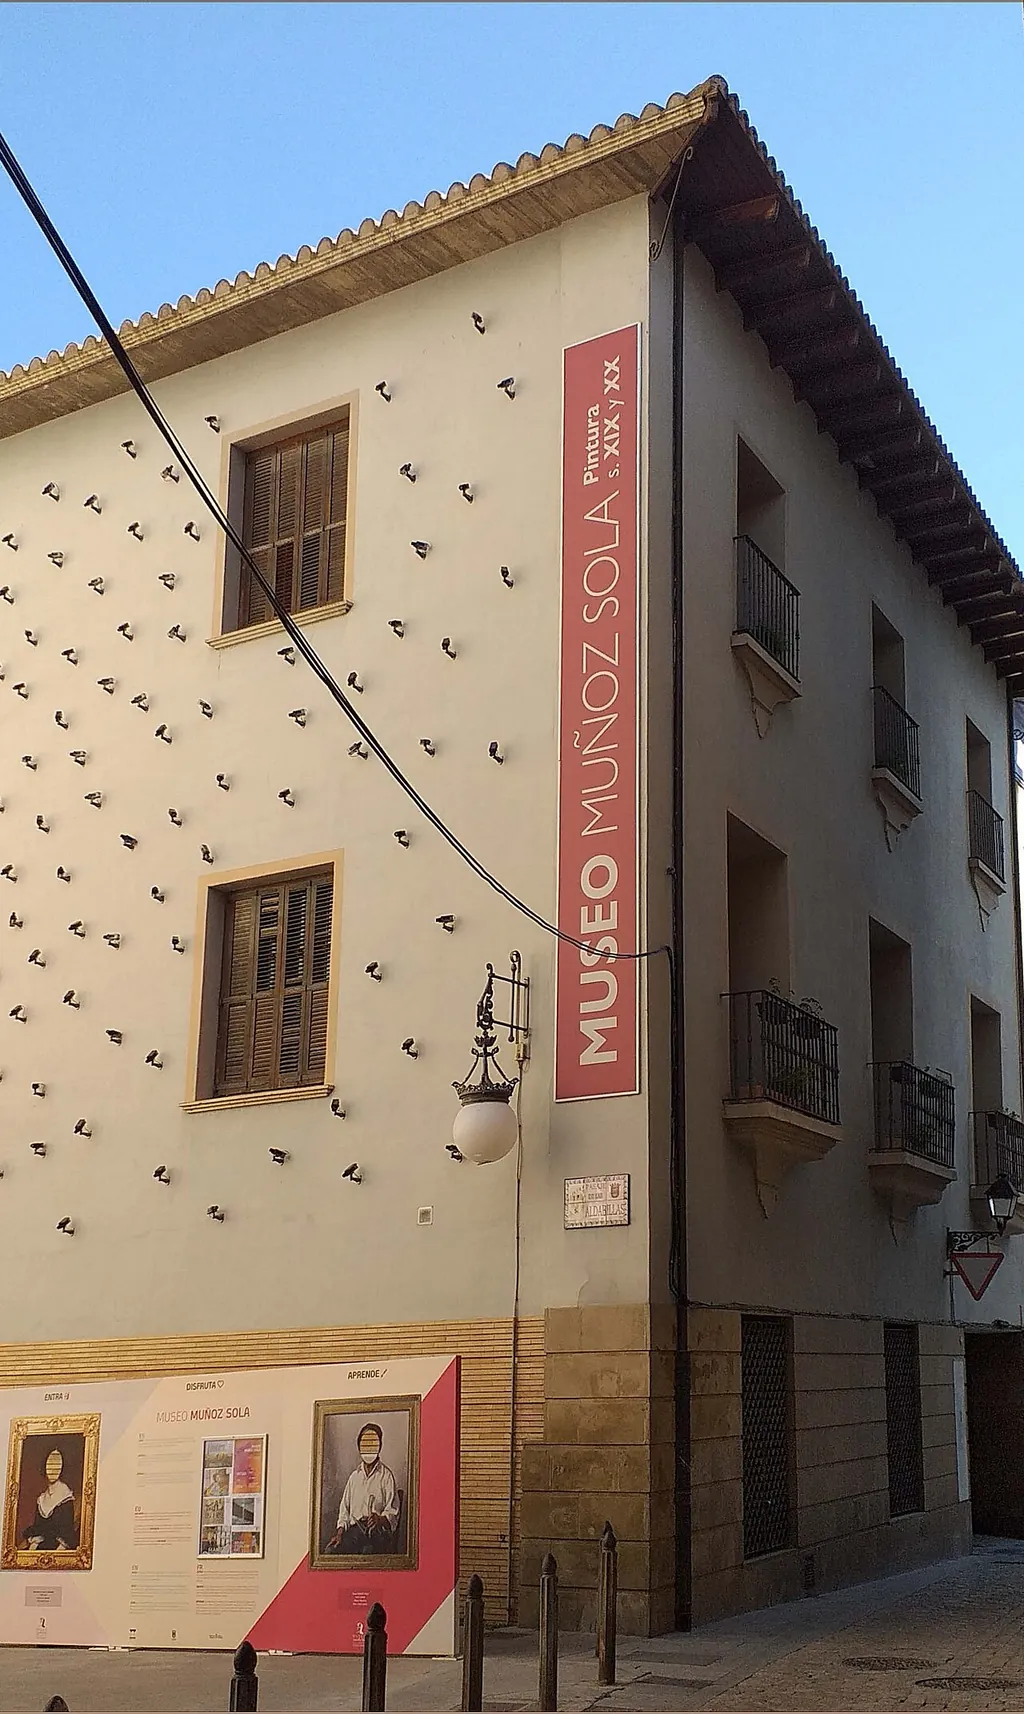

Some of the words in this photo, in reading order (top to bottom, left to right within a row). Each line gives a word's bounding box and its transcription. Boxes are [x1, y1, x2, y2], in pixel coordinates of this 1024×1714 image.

[603, 354, 620, 396] XX
[608, 399, 625, 410] y
[583, 403, 600, 486] Pintura
[603, 412, 620, 461] XIX
[608, 463, 620, 478] s.
[582, 489, 620, 624] SOLA
[573, 632, 620, 837] MUÑOZ
[579, 854, 619, 1066] MUSEO
[186, 1381, 216, 1391] DISFRUTA
[347, 1369, 380, 1379] APRENDE
[44, 1392, 63, 1401] ENTRA
[157, 1411, 188, 1423] MUSEO
[190, 1407, 223, 1420] MUÑOZ
[226, 1406, 250, 1418] SOLA
